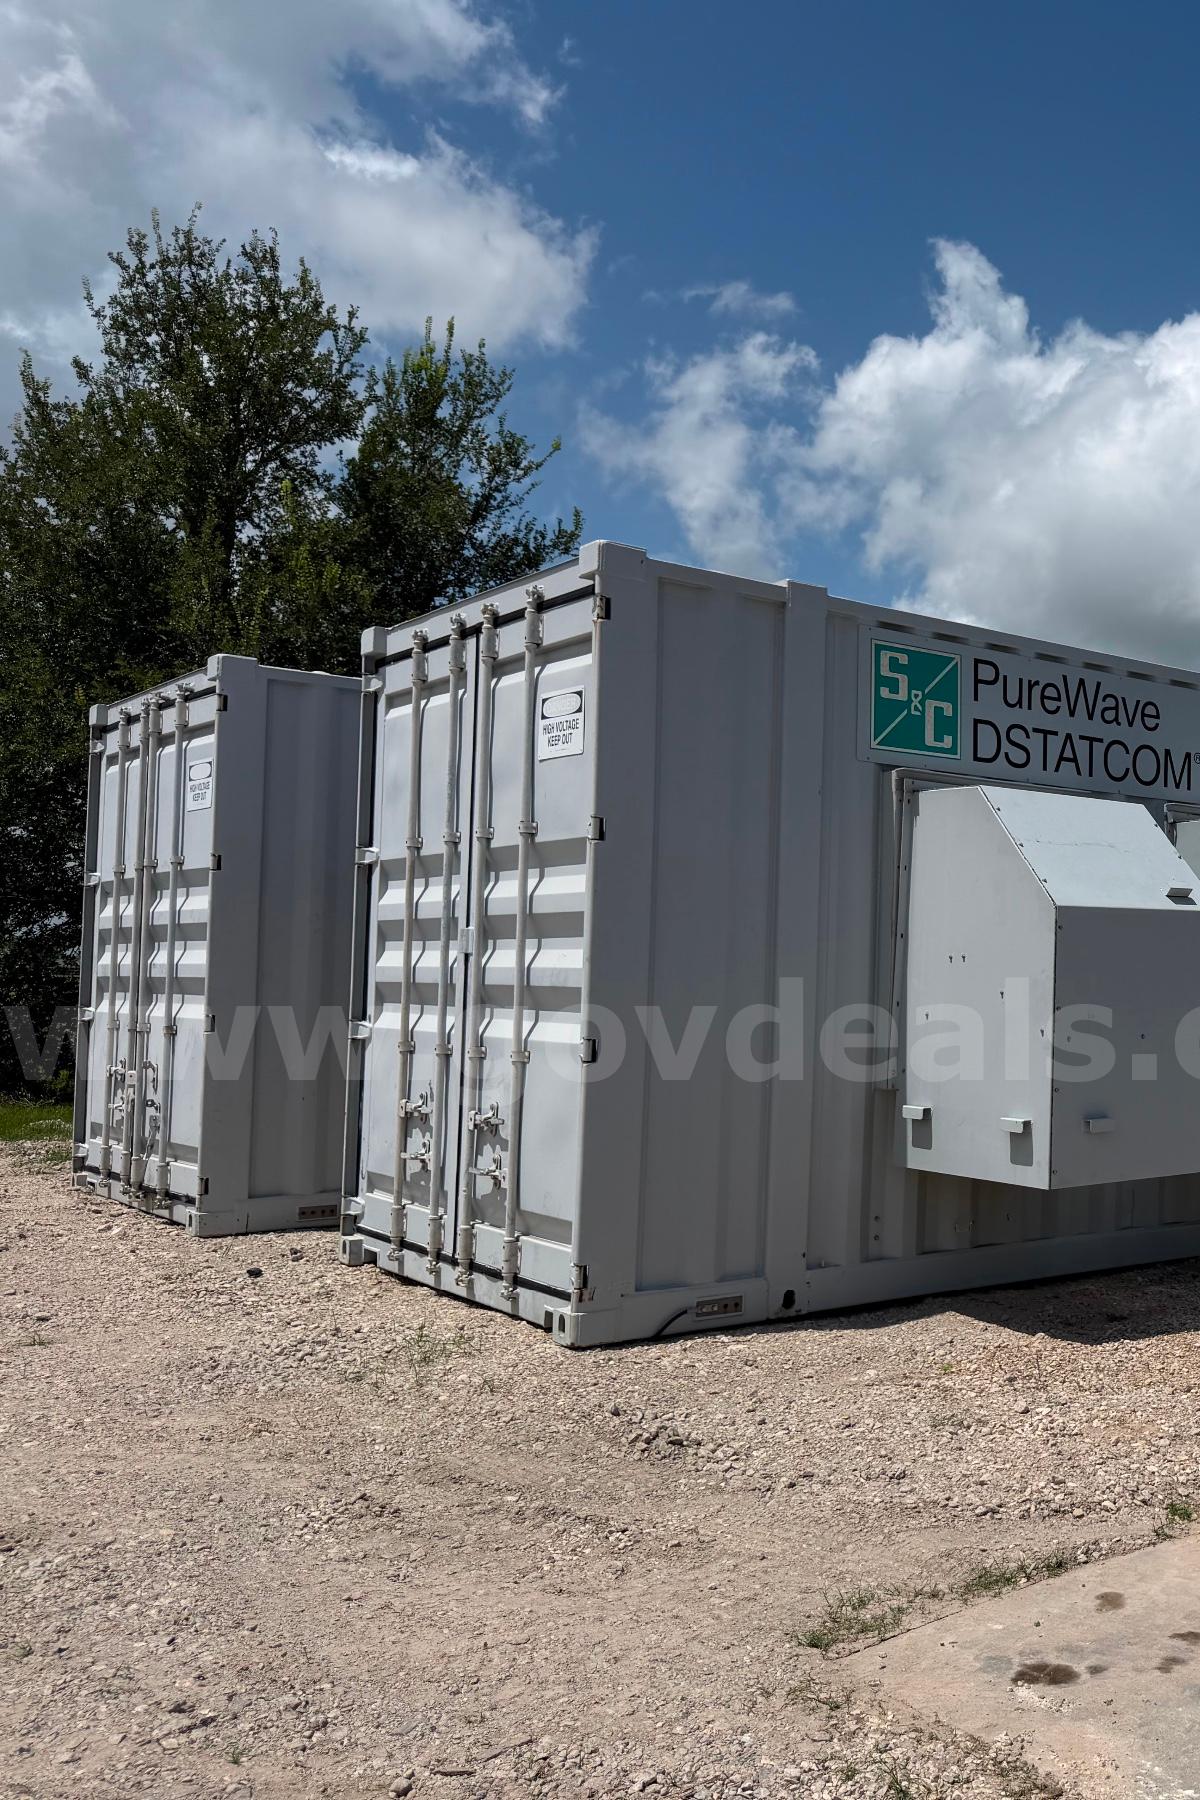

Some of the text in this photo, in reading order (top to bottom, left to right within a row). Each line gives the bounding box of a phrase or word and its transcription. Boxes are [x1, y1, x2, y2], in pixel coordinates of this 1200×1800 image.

[972, 657, 1161, 732] PureWave
[543, 718, 579, 736] HIGH VOLTAGE
[548, 732, 573, 747] KEEP OUT
